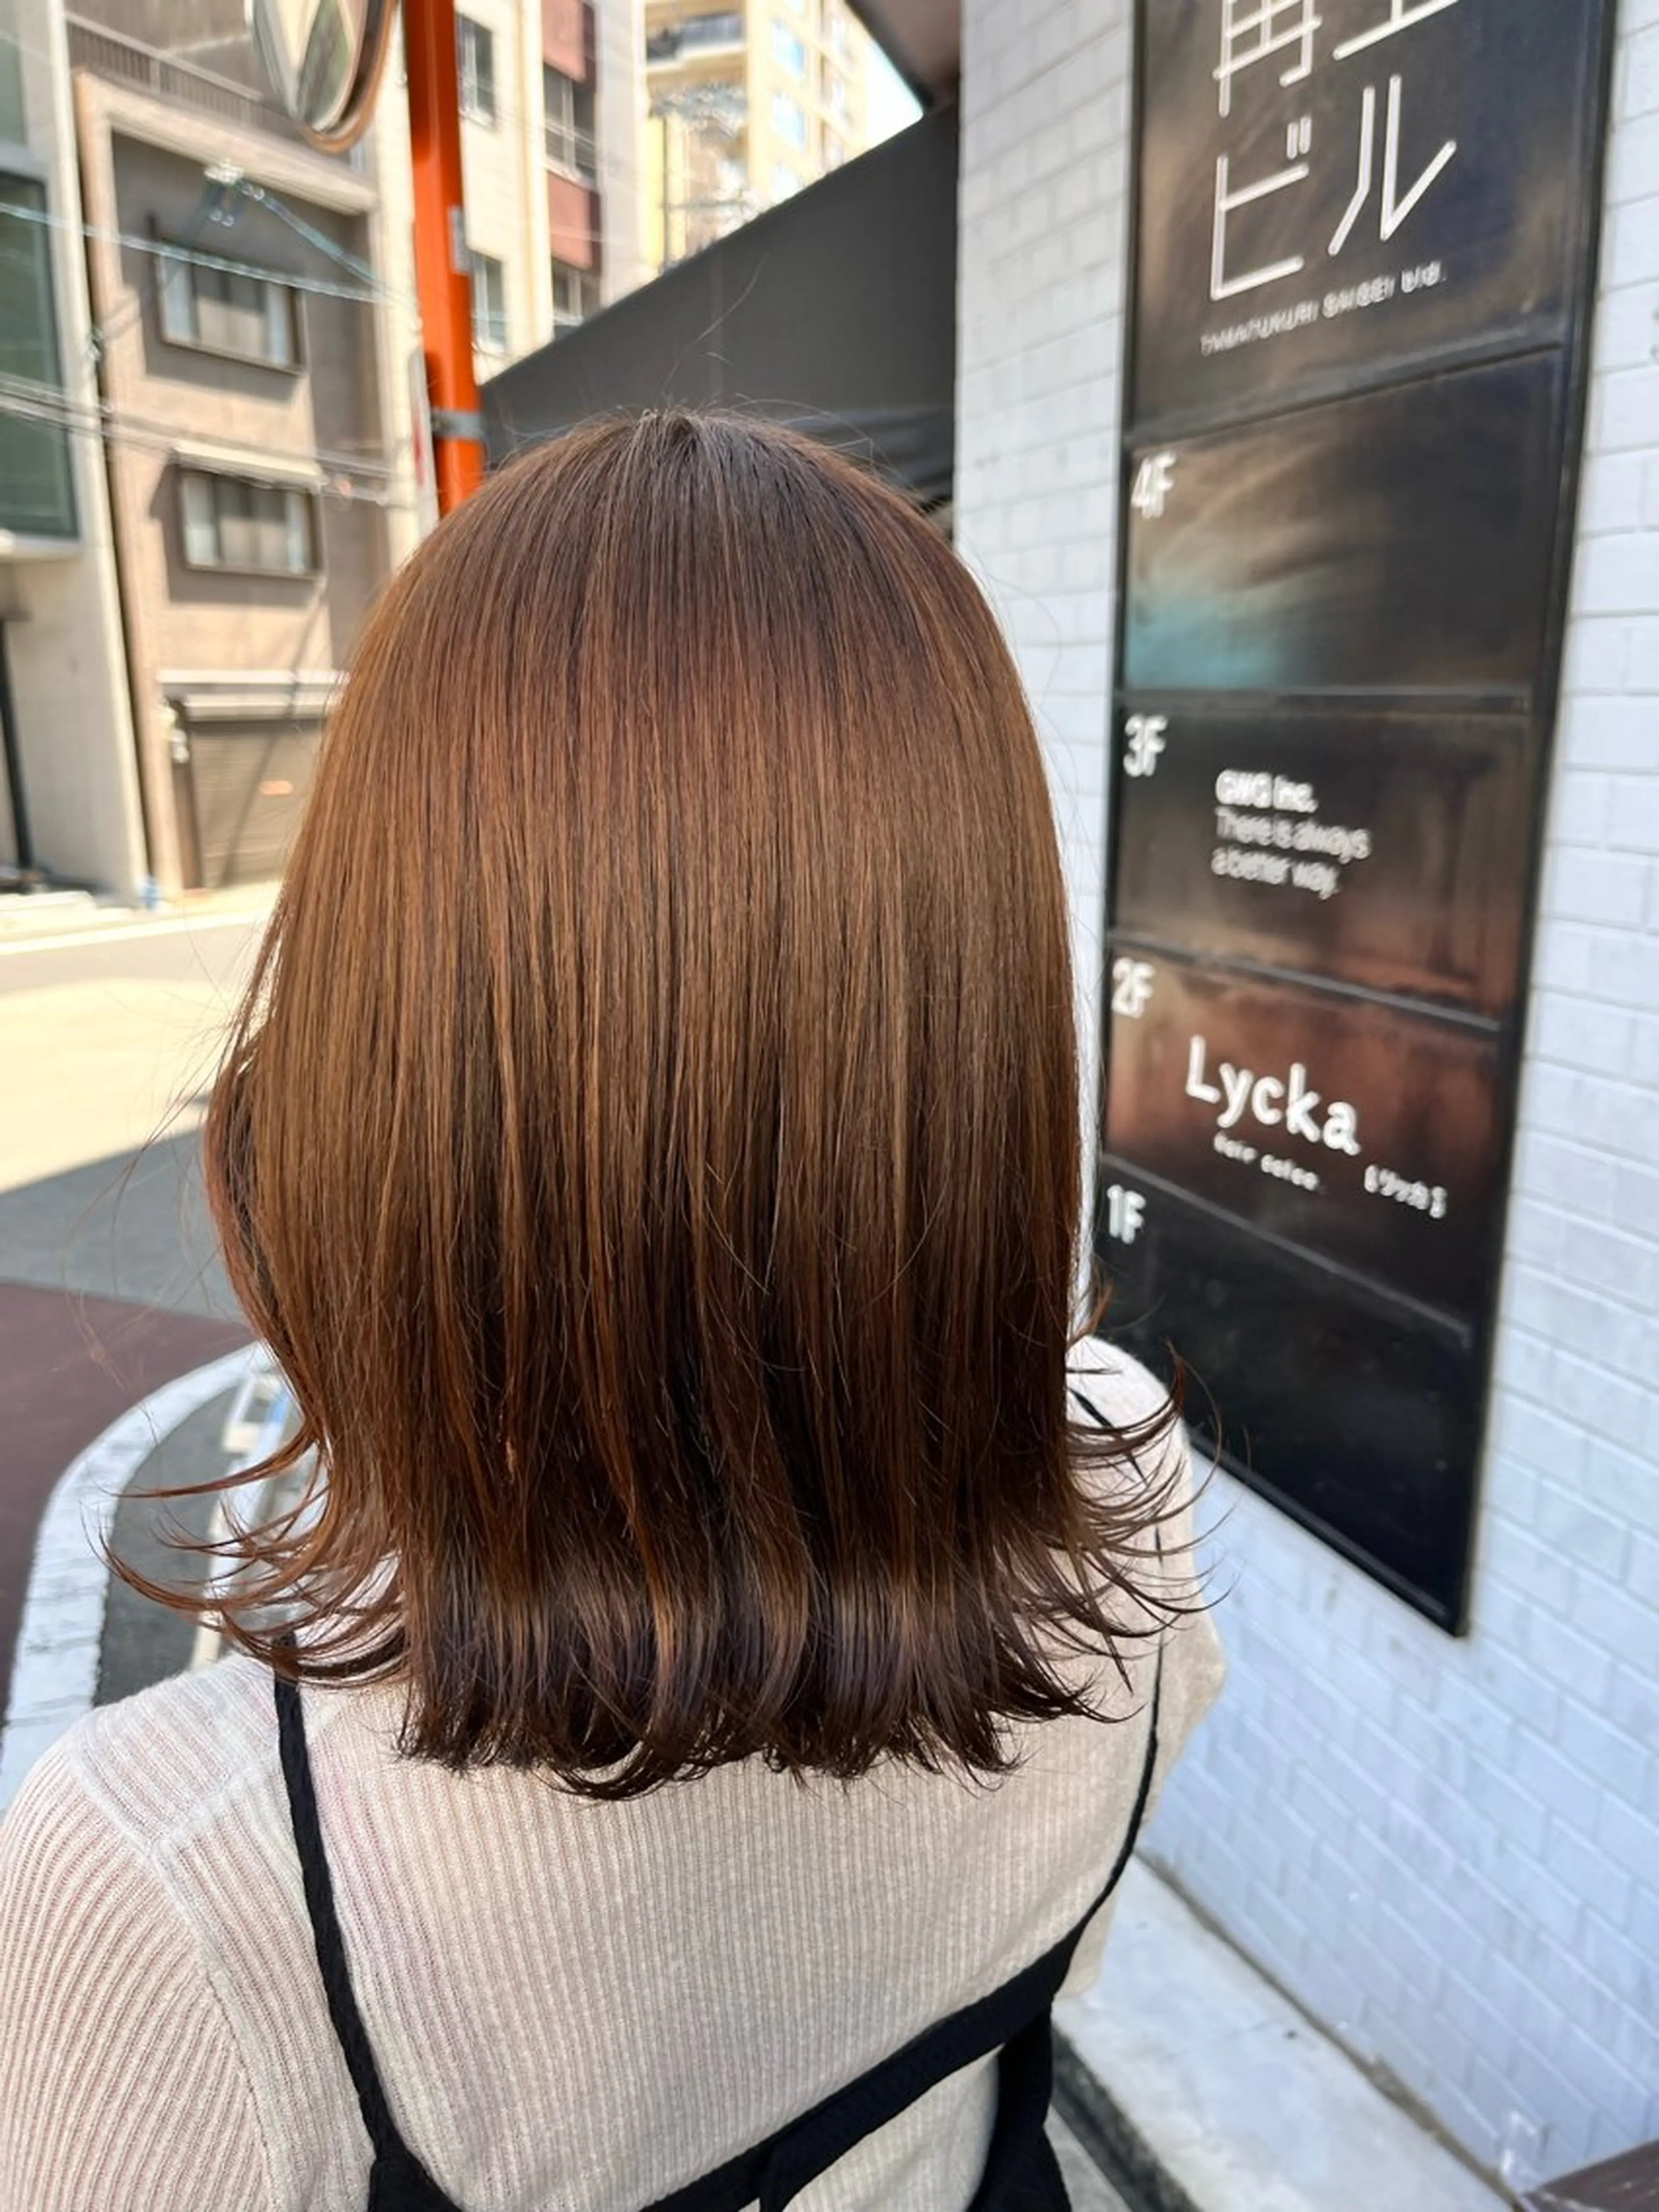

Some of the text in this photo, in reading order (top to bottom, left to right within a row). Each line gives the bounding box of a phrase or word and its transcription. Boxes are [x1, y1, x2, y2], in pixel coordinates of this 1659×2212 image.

[1211, 73, 1457, 301] ビル
[1131, 451, 1177, 518] 4F
[1123, 714, 1169, 777] 3F
[1112, 957, 1156, 1019] 2F
[1185, 1033, 1361, 1156] Lycka
[1107, 1184, 1147, 1243] 1F
